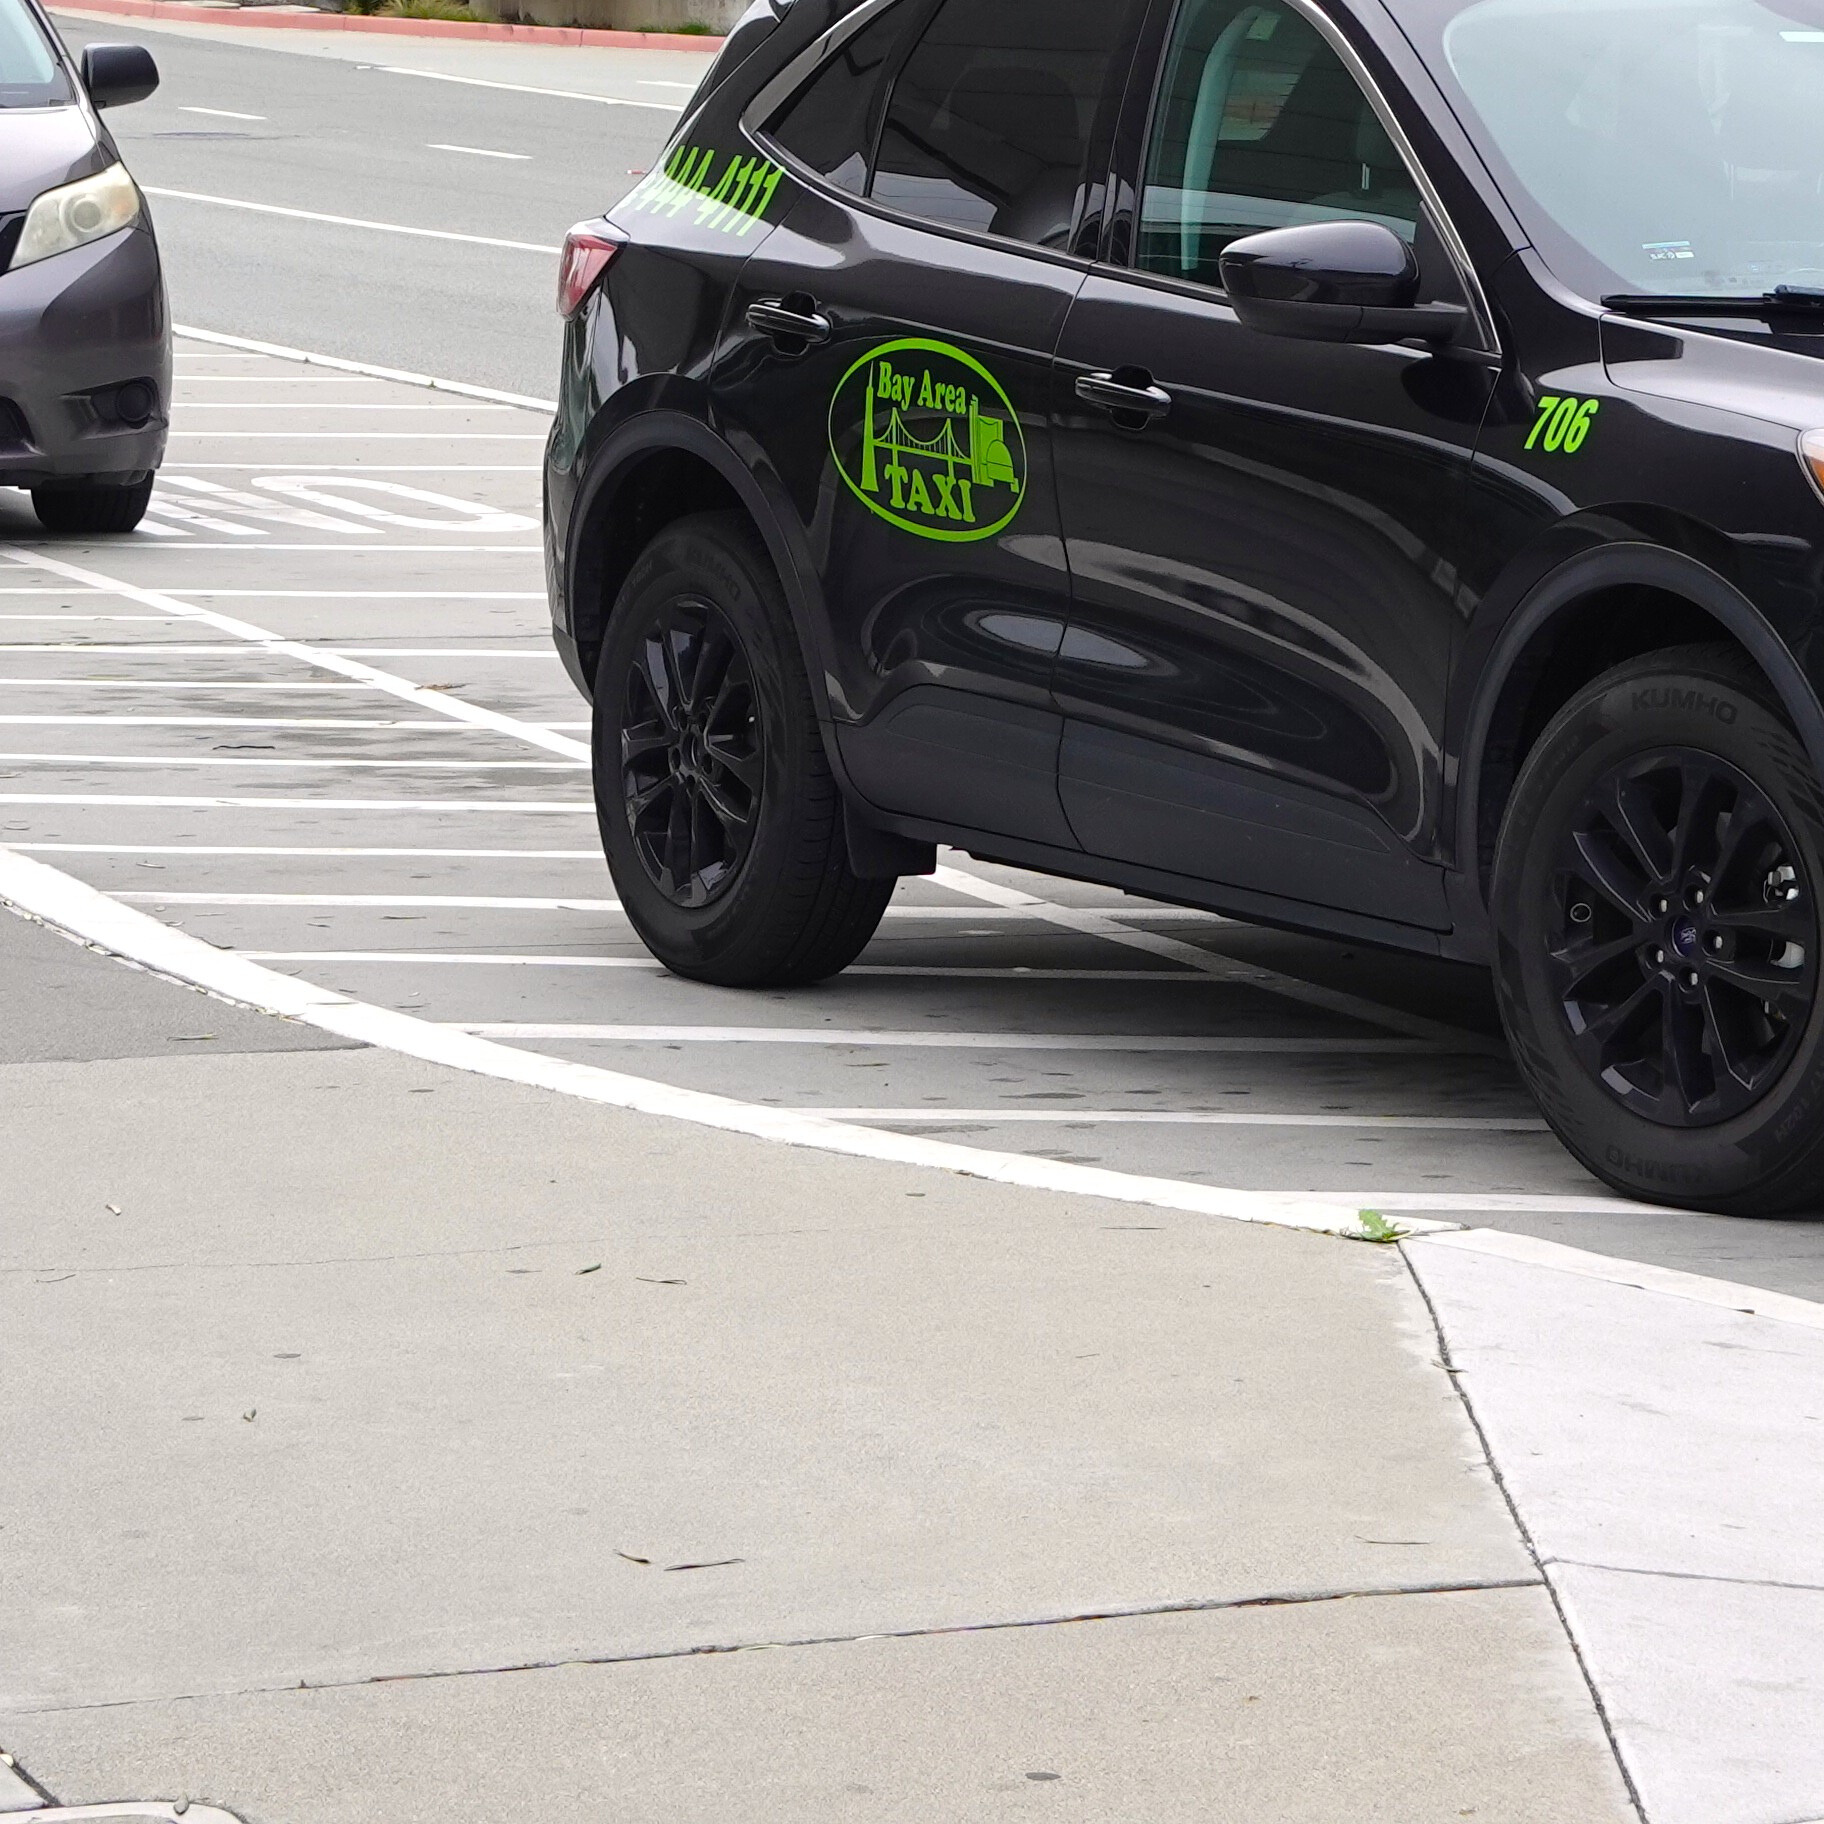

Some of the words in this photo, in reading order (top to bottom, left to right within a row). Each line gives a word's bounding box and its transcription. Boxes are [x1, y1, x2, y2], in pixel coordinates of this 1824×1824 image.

[877, 361, 915, 412] Bay
[917, 369, 966, 415] Area
[1524, 396, 1599, 453] 706
[884, 464, 976, 523] TAXI
[1631, 687, 1738, 725] KUMHO
